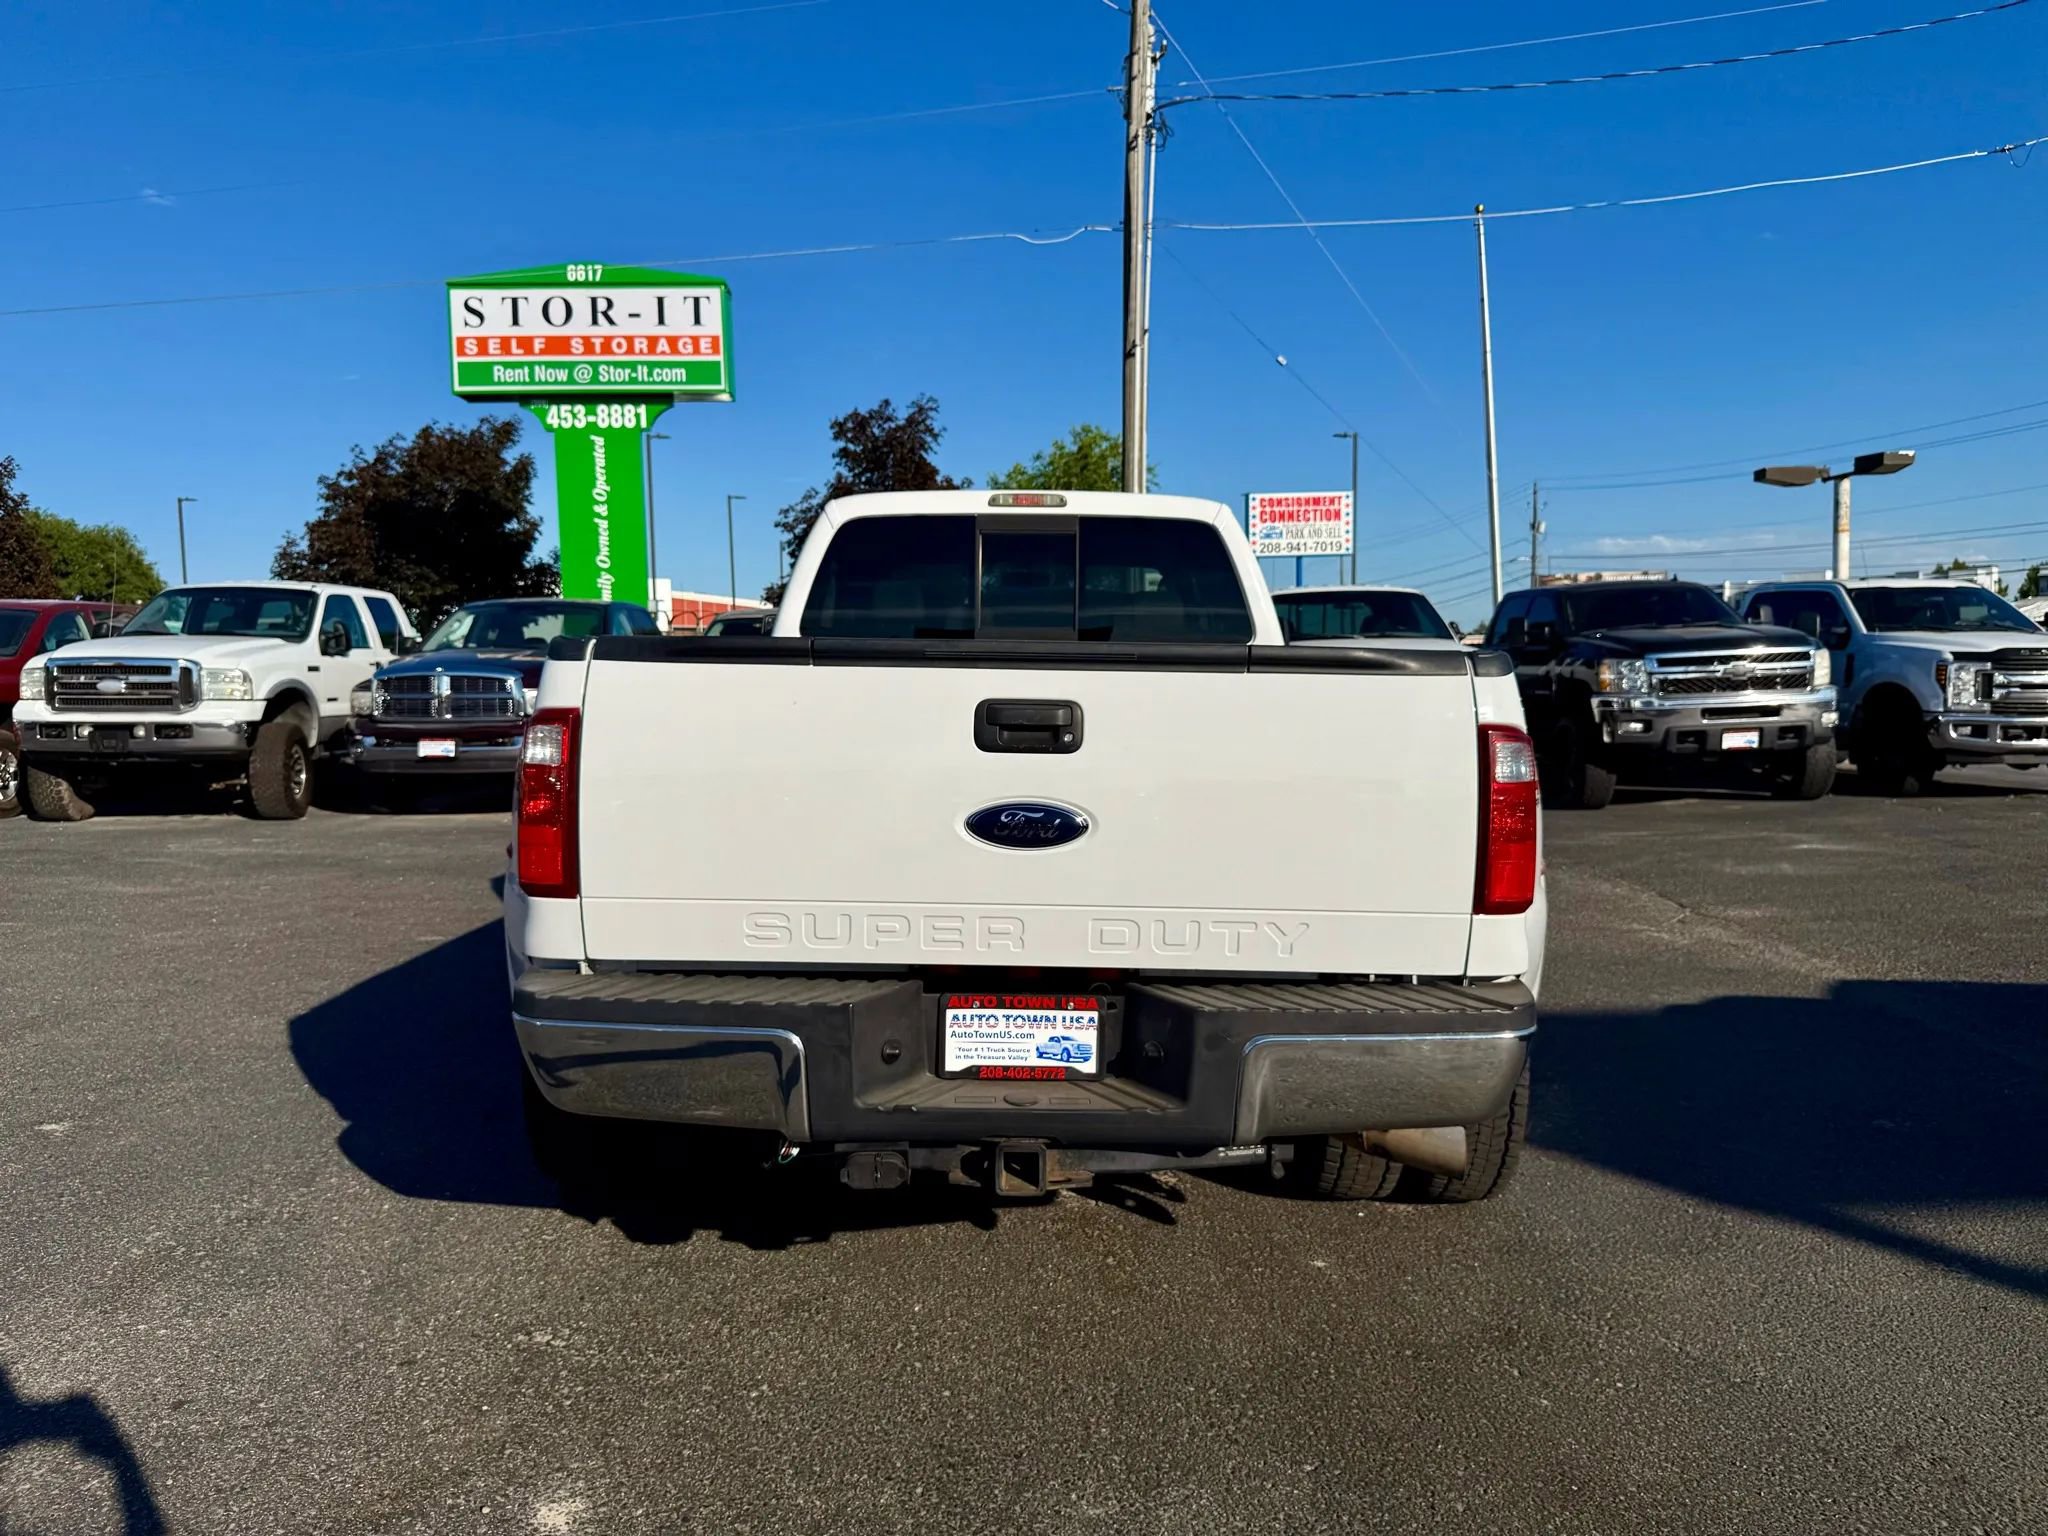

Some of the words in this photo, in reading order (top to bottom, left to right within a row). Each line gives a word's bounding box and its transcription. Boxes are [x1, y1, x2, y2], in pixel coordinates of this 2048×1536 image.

[463, 296, 711, 329] STOR-IT
[463, 337, 547, 355] SELF
[570, 337, 713, 355] STORAGE
[493, 366, 531, 383] Rent
[534, 367, 568, 383] Now
[573, 365, 593, 384] @
[599, 365, 687, 384] Stor-It.com
[546, 403, 648, 430] 453-8881
[589, 434, 611, 502] Operated
[592, 503, 609, 517] &
[1260, 496, 1343, 508] CONSIGNMENT
[1260, 509, 1342, 523] CONNECTION
[1285, 528, 1305, 540] PARK
[1307, 527, 1323, 539] AND
[1325, 526, 1343, 538] SELL
[593, 518, 611, 569] Owned
[1259, 541, 1343, 554] 208-941-7019
[993, 810, 1061, 839] Ford
[743, 912, 1027, 953] SUPER
[1088, 916, 1311, 958] DUTY
[948, 995, 998, 1008] AUTO
[1002, 996, 1056, 1009] TOWN
[1061, 998, 1099, 1010] USA
[949, 1013, 999, 1028] AUTO
[1002, 1014, 1057, 1030] TOWN
[1062, 1015, 1098, 1031] USA
[950, 1030, 1035, 1040] AutoTownUS.com
